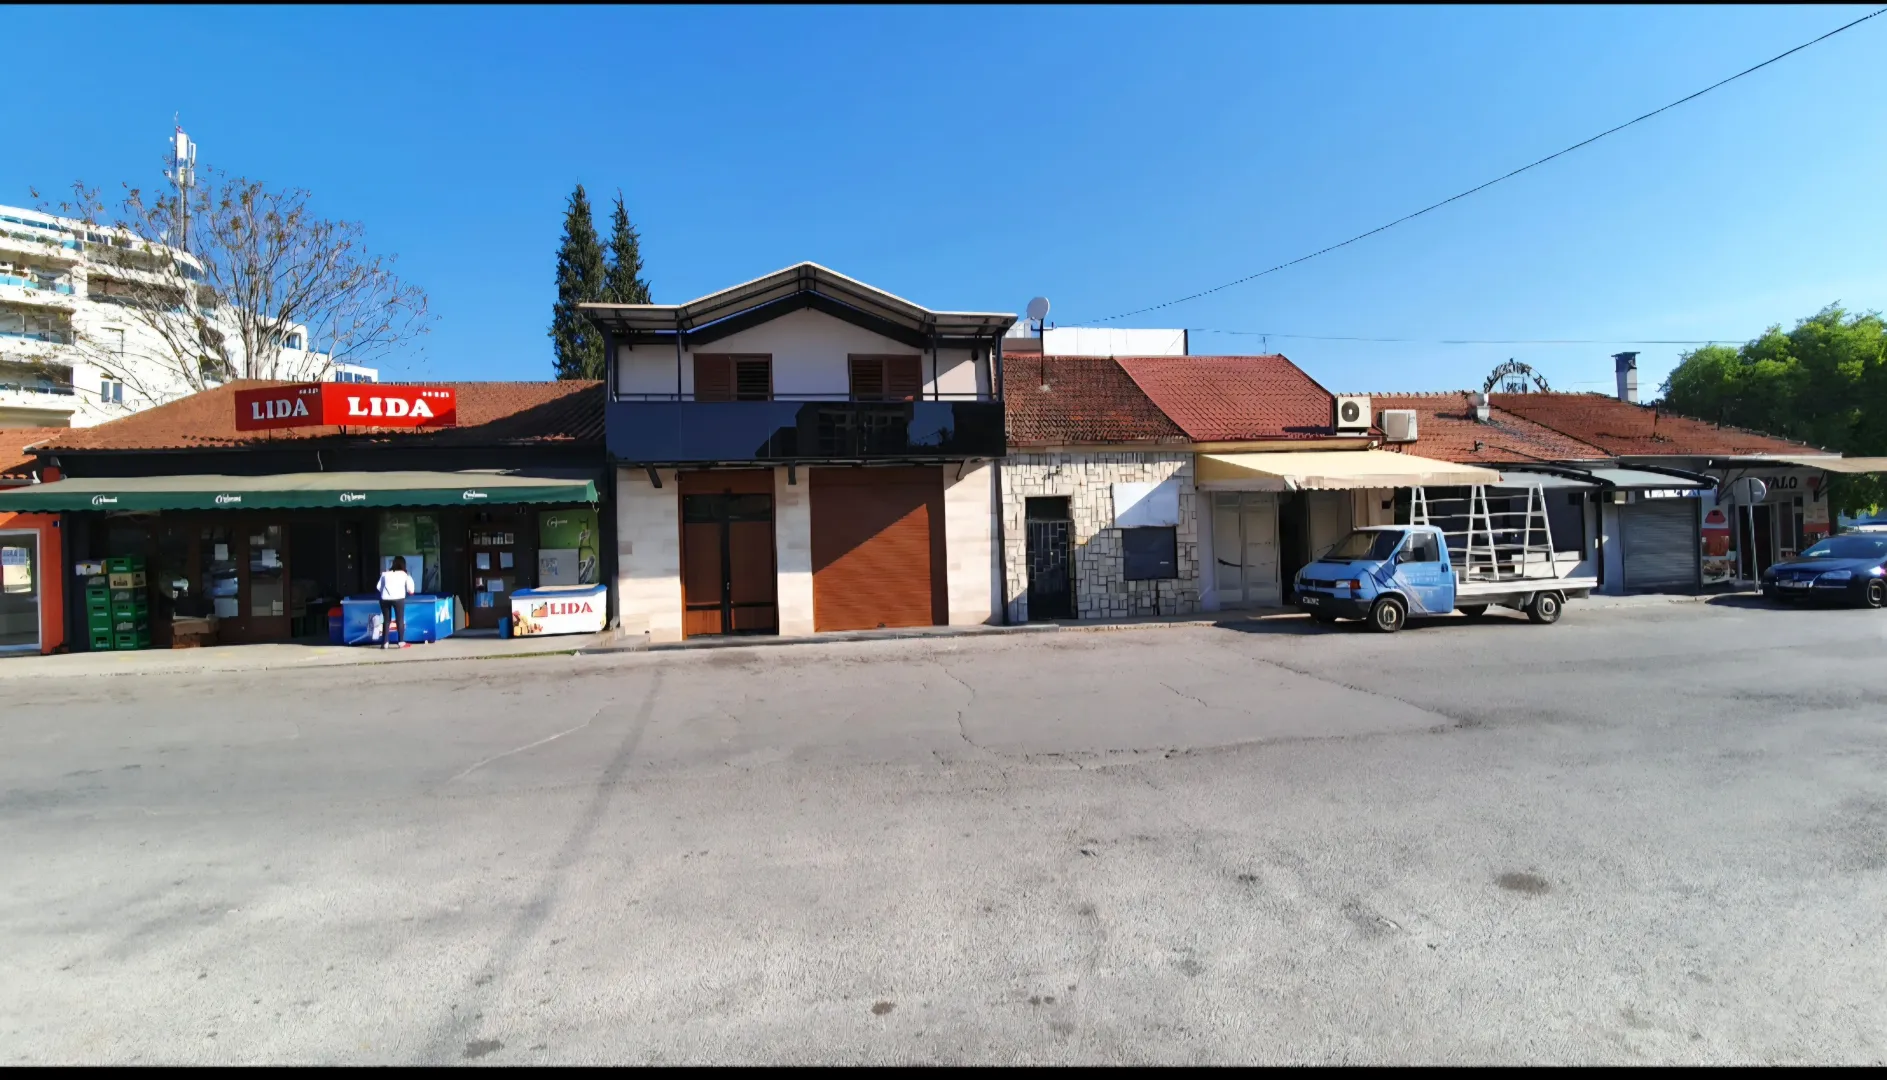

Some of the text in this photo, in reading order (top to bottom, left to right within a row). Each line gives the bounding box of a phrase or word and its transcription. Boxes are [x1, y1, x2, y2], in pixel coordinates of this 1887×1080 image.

[252, 398, 309, 420] LIDA
[347, 396, 434, 418] LIDA
[550, 601, 593, 615] LIDA
